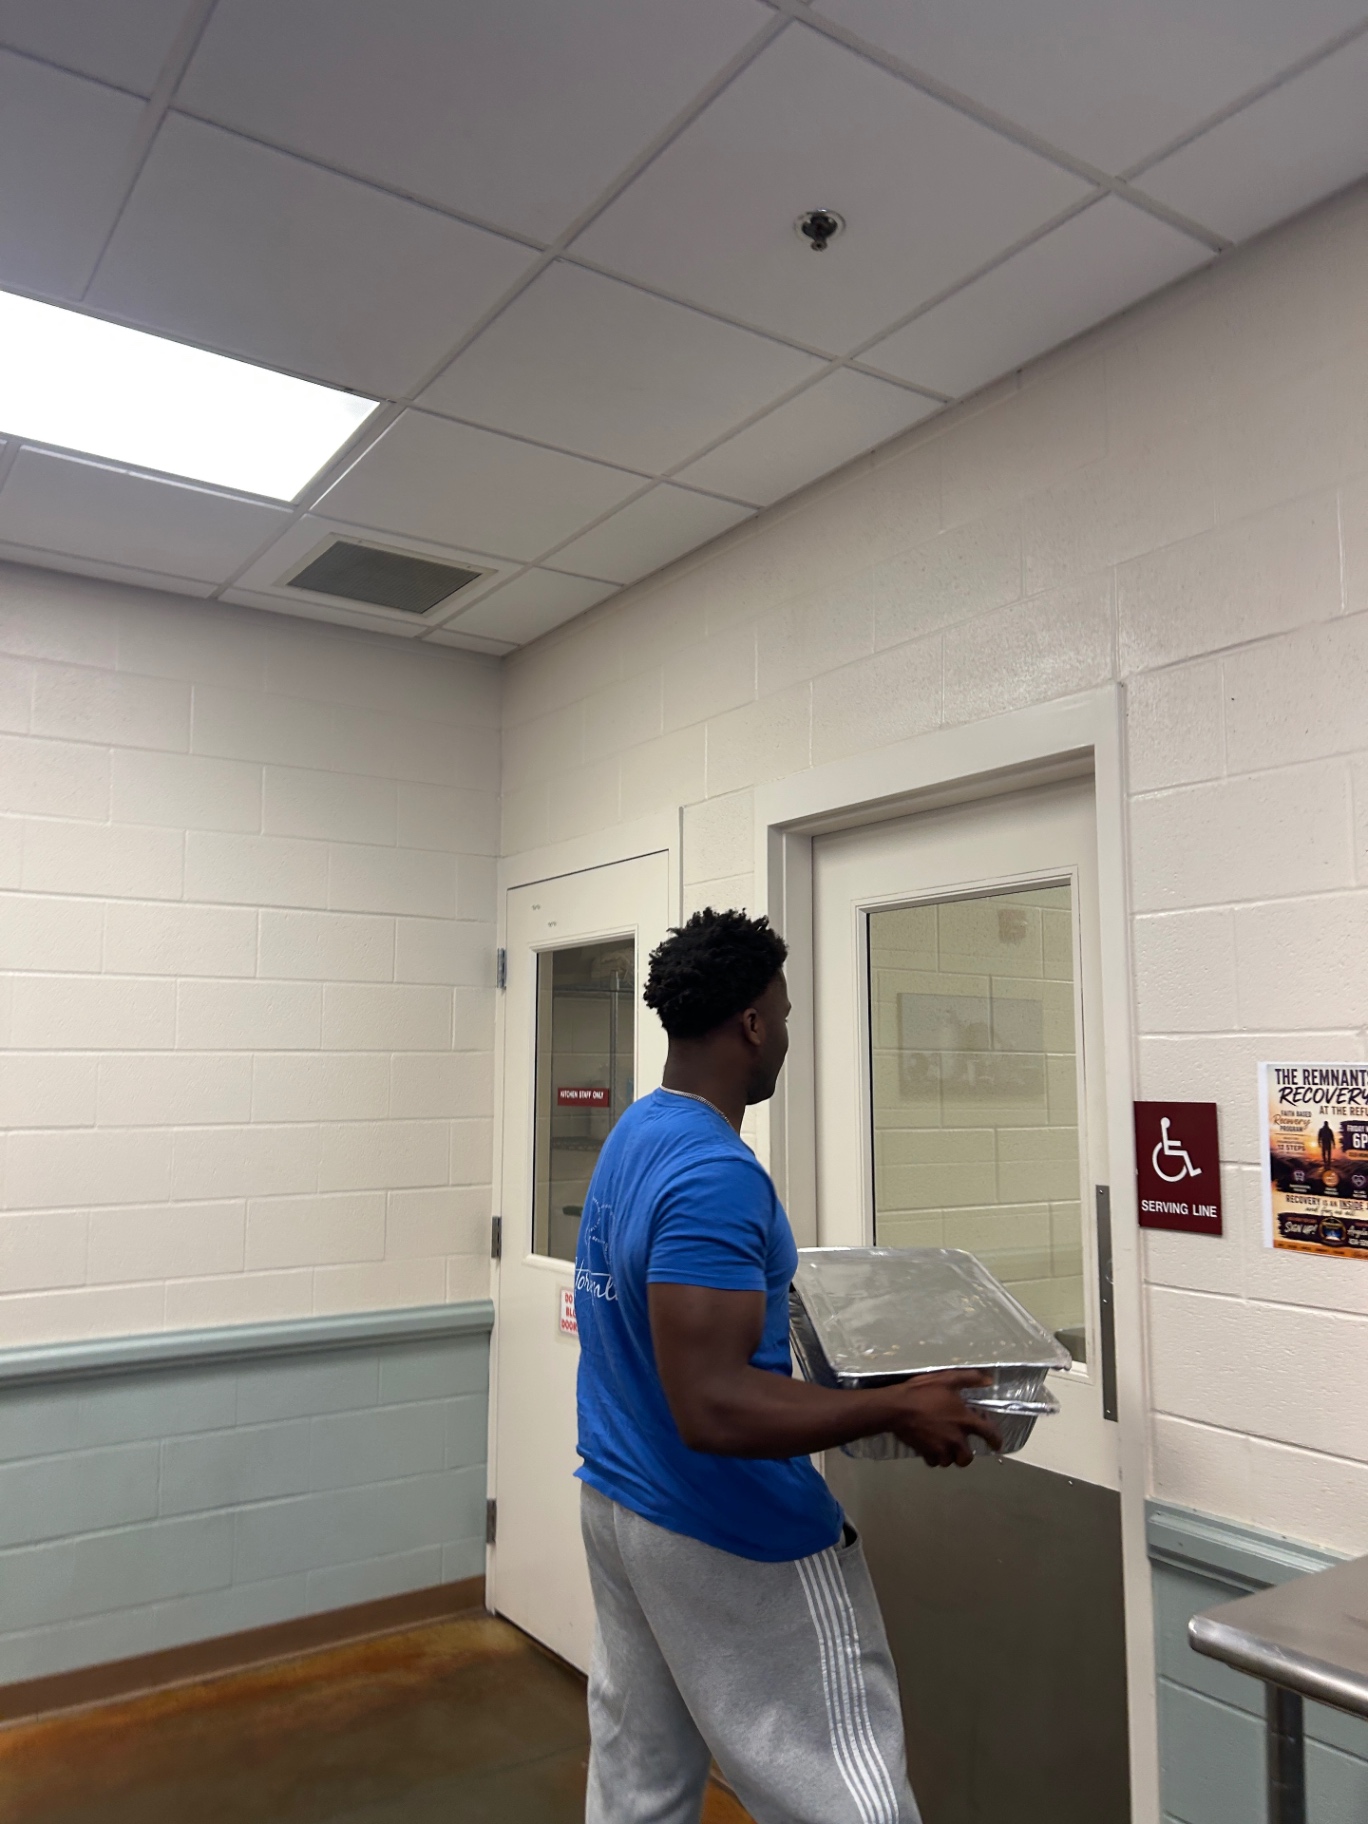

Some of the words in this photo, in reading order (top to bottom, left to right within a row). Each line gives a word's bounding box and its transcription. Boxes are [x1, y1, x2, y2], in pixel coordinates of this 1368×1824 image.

[1275, 1069, 1298, 1085] THE
[1302, 1069, 1368, 1087] REMNANT
[560, 1090, 578, 1099] KITCHEN
[579, 1090, 591, 1099] STAFF
[592, 1090, 604, 1100] ONLY
[1278, 1086, 1368, 1107] RECOVERY
[1319, 1106, 1329, 1115] AT
[1332, 1106, 1347, 1116] THE
[1273, 1114, 1311, 1129] Recovery
[1286, 1144, 1306, 1152] STEPS
[1286, 1195, 1320, 1205] RECOVERY
[1141, 1199, 1189, 1215] SERVING
[1192, 1204, 1218, 1218] LINE
[564, 1292, 574, 1305] DO
